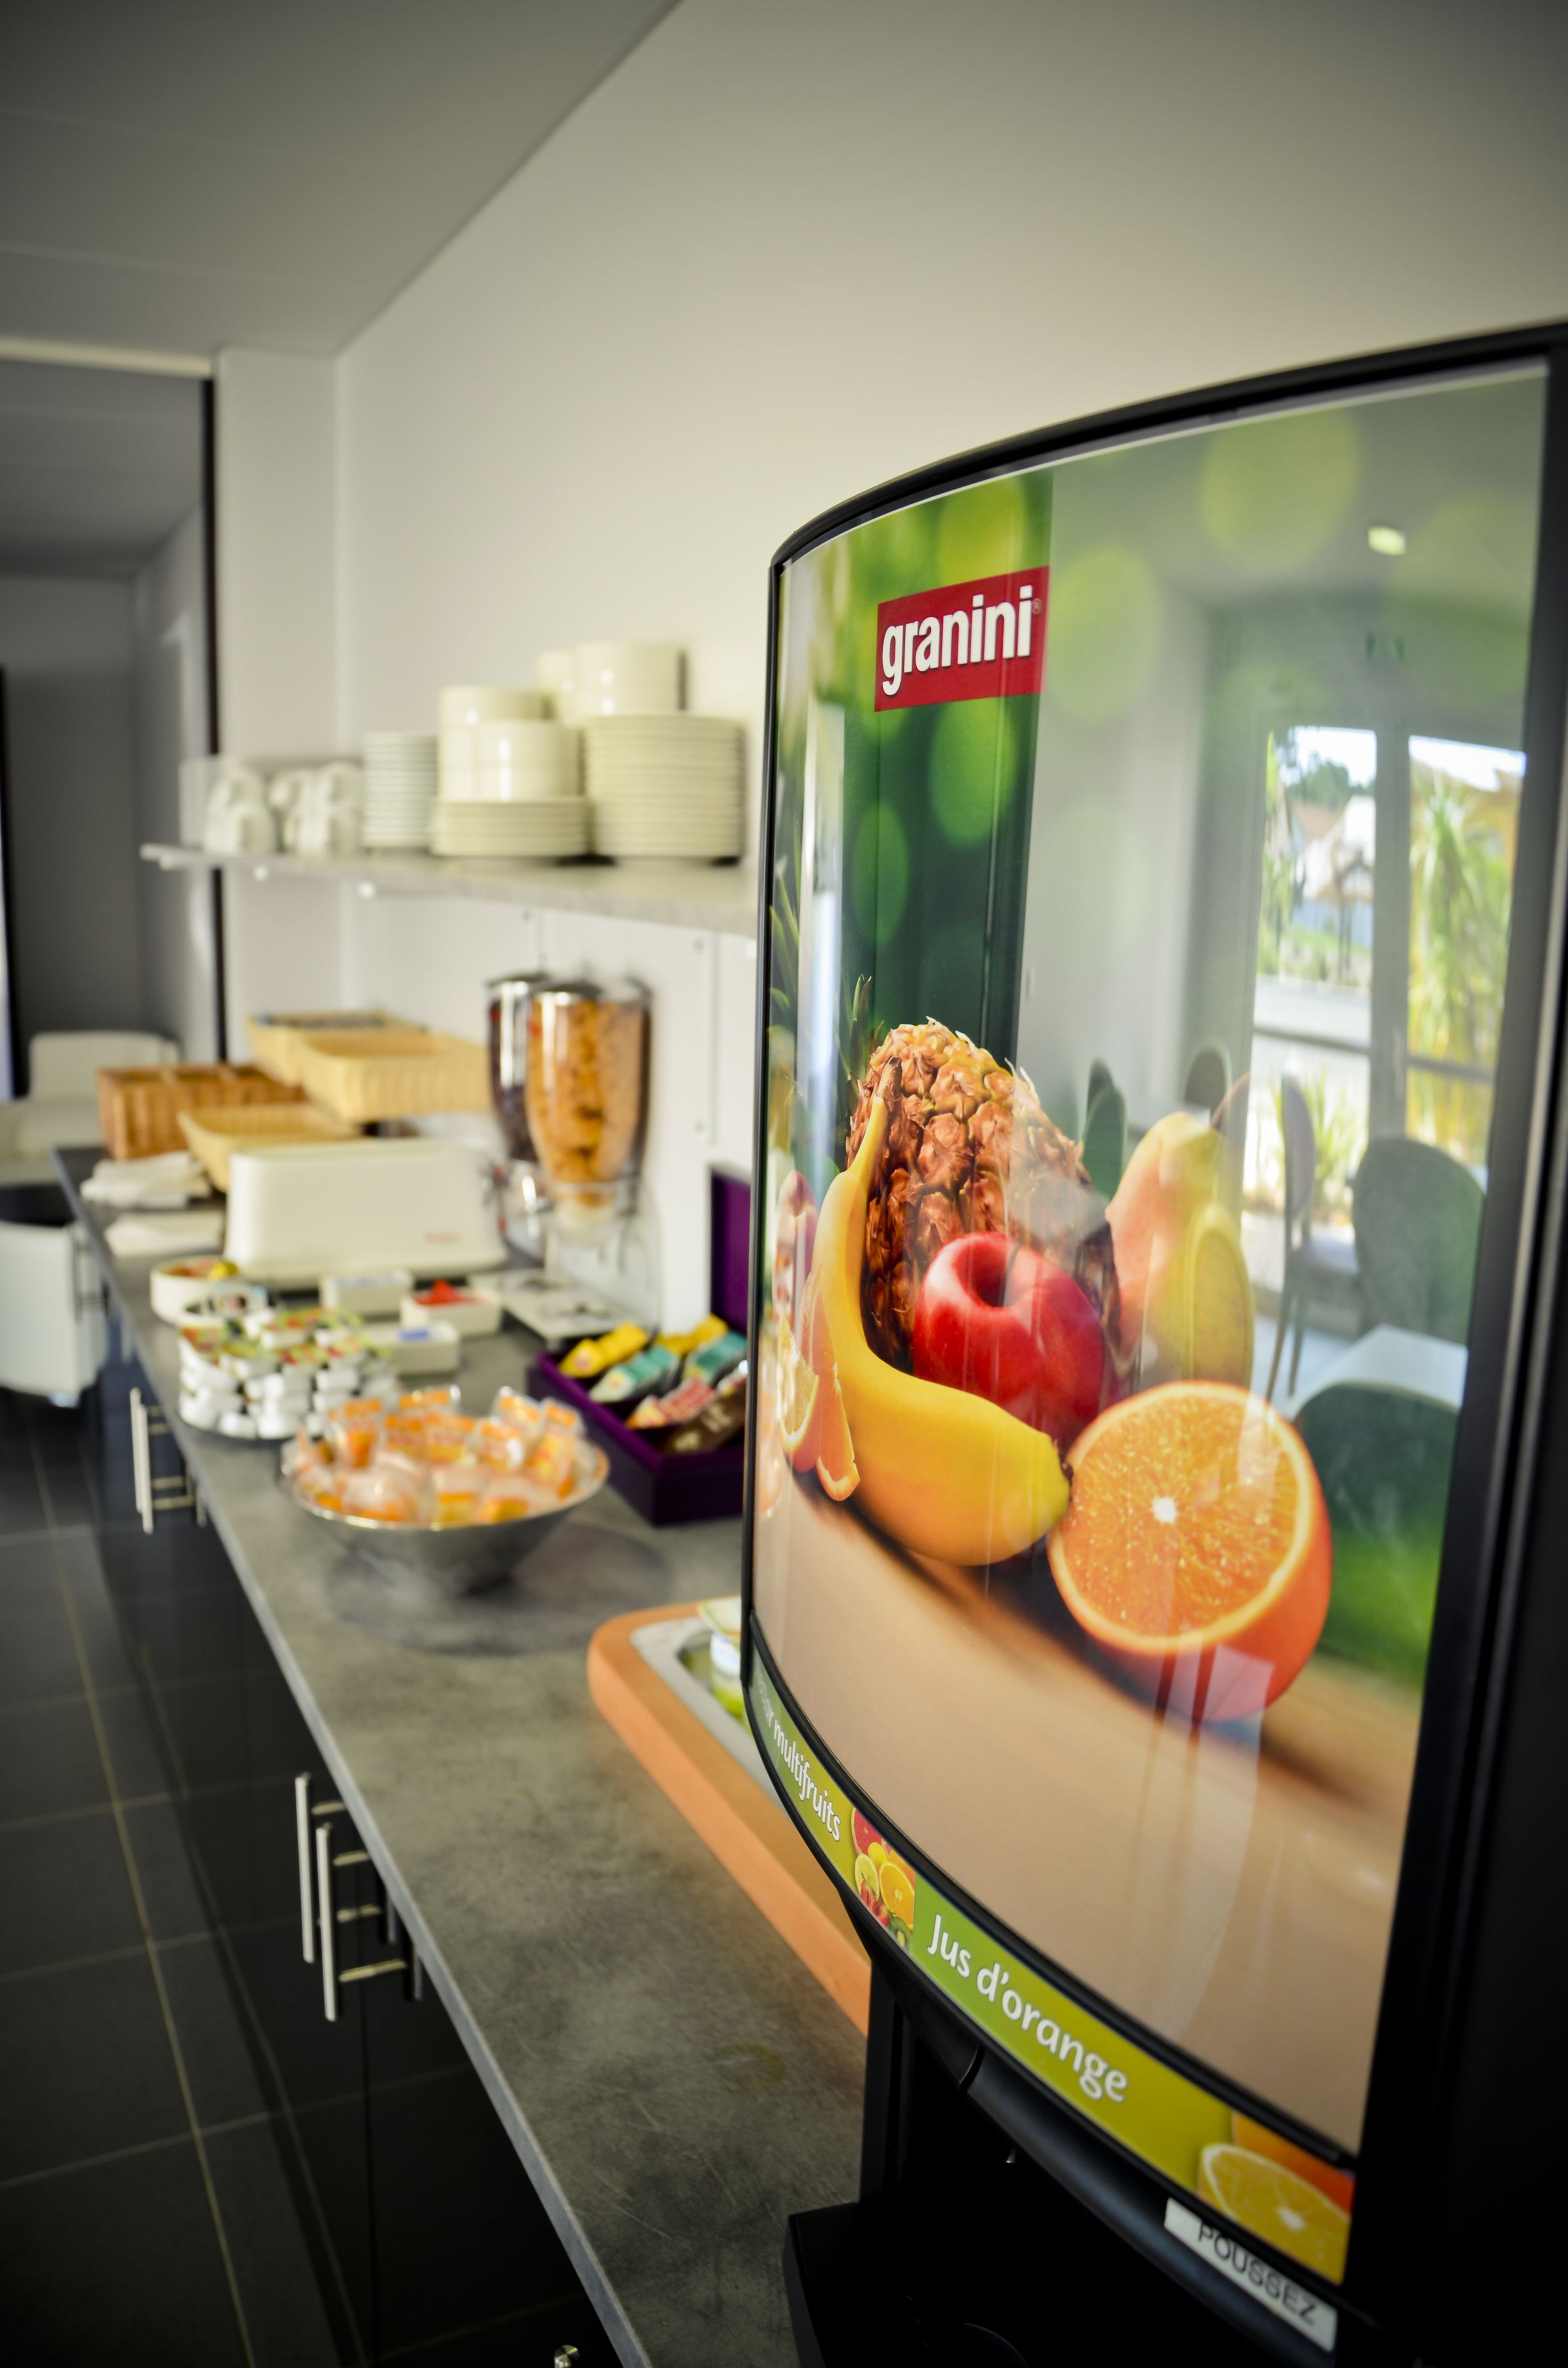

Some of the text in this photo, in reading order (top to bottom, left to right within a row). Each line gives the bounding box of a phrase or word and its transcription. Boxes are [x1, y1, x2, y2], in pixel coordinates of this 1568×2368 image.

[882, 585, 1033, 696] granini
[773, 1719, 841, 1841] multifruits
[927, 1914, 1128, 2103] Jus d'orange
[1198, 2221, 1316, 2326] POUSSEZ
